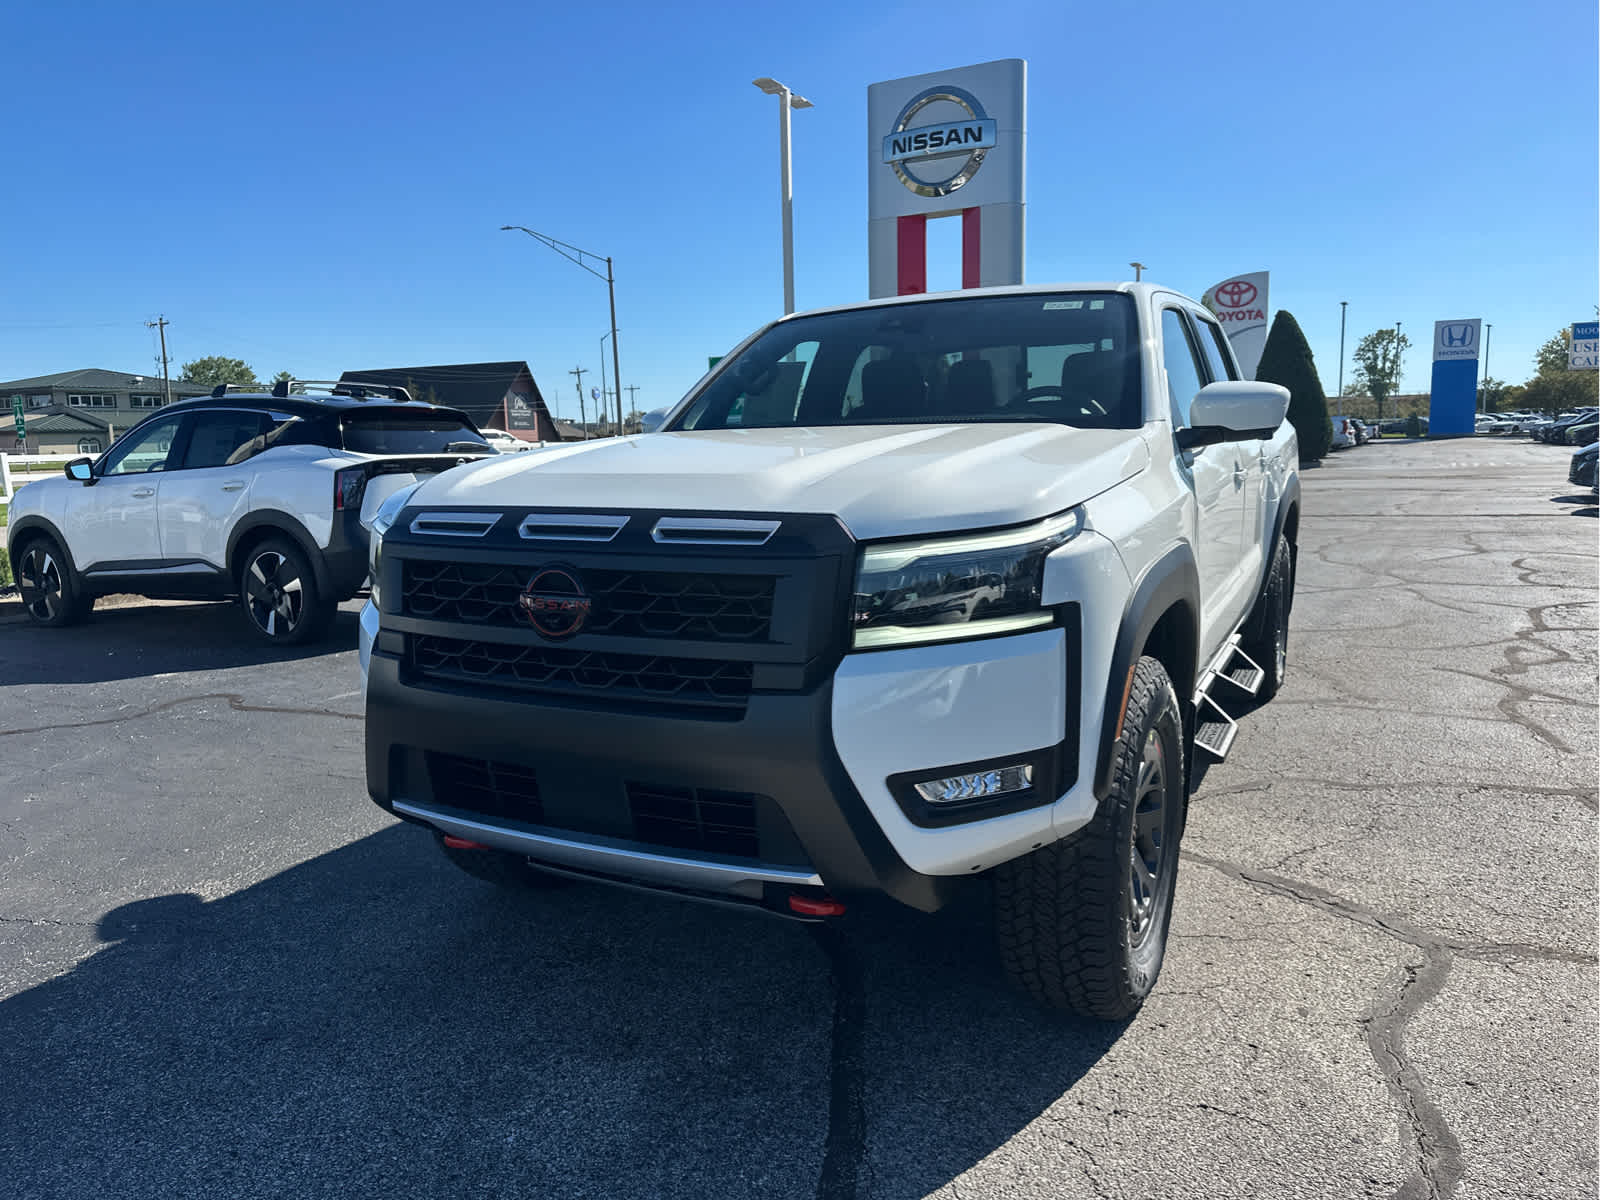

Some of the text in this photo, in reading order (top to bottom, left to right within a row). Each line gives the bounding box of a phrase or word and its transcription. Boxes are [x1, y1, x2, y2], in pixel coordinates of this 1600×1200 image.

[892, 126, 982, 155] NISSAN
[1217, 310, 1264, 322] OYOTA
[520, 595, 590, 610] NISSAN
